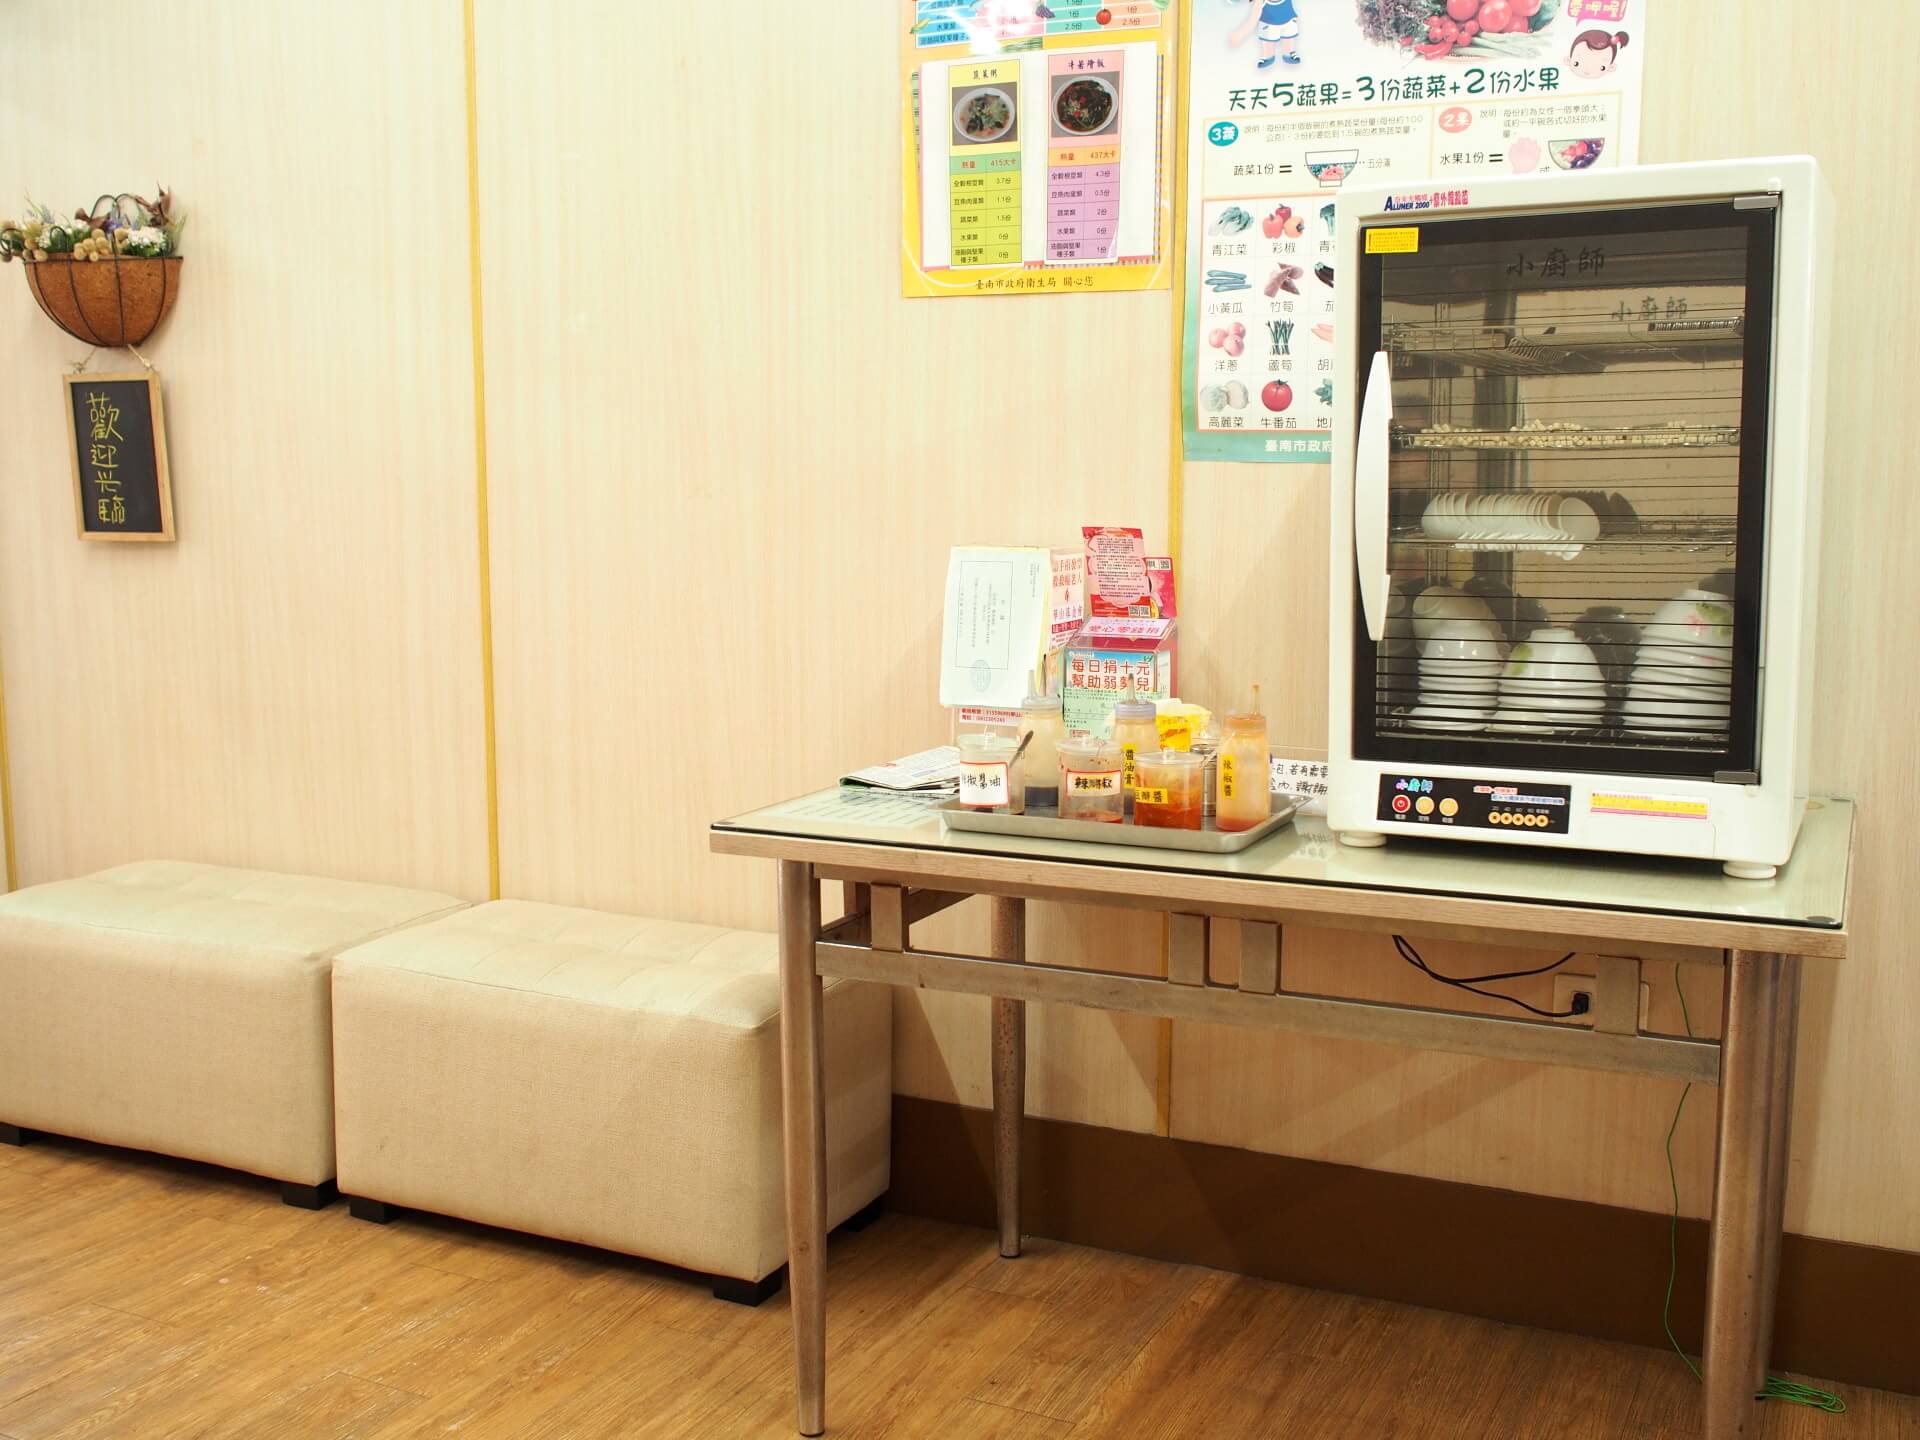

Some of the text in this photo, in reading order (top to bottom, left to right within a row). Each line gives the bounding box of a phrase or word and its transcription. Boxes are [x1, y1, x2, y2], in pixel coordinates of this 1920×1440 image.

[1439, 152, 1485, 165] 水果1份
[1233, 163, 1274, 176] 蔬菜1份
[1212, 243, 1247, 256] 青江菜
[1272, 242, 1296, 254] 彩椒
[1319, 240, 1335, 253] 青
[1506, 246, 1606, 279] 小廚師
[975, 275, 1094, 290] 臺南市政府衛生局 關心您
[1208, 302, 1243, 314] 小黃瓜
[1270, 301, 1294, 313] 竹筍
[1317, 358, 1333, 371] 胡
[1208, 416, 1244, 429] 高麗菜
[1261, 417, 1297, 429] 牛番茄
[1317, 417, 1332, 429] 地
[1072, 658, 1150, 676] 每日捐十元
[1124, 749, 1135, 784] 醬油膏
